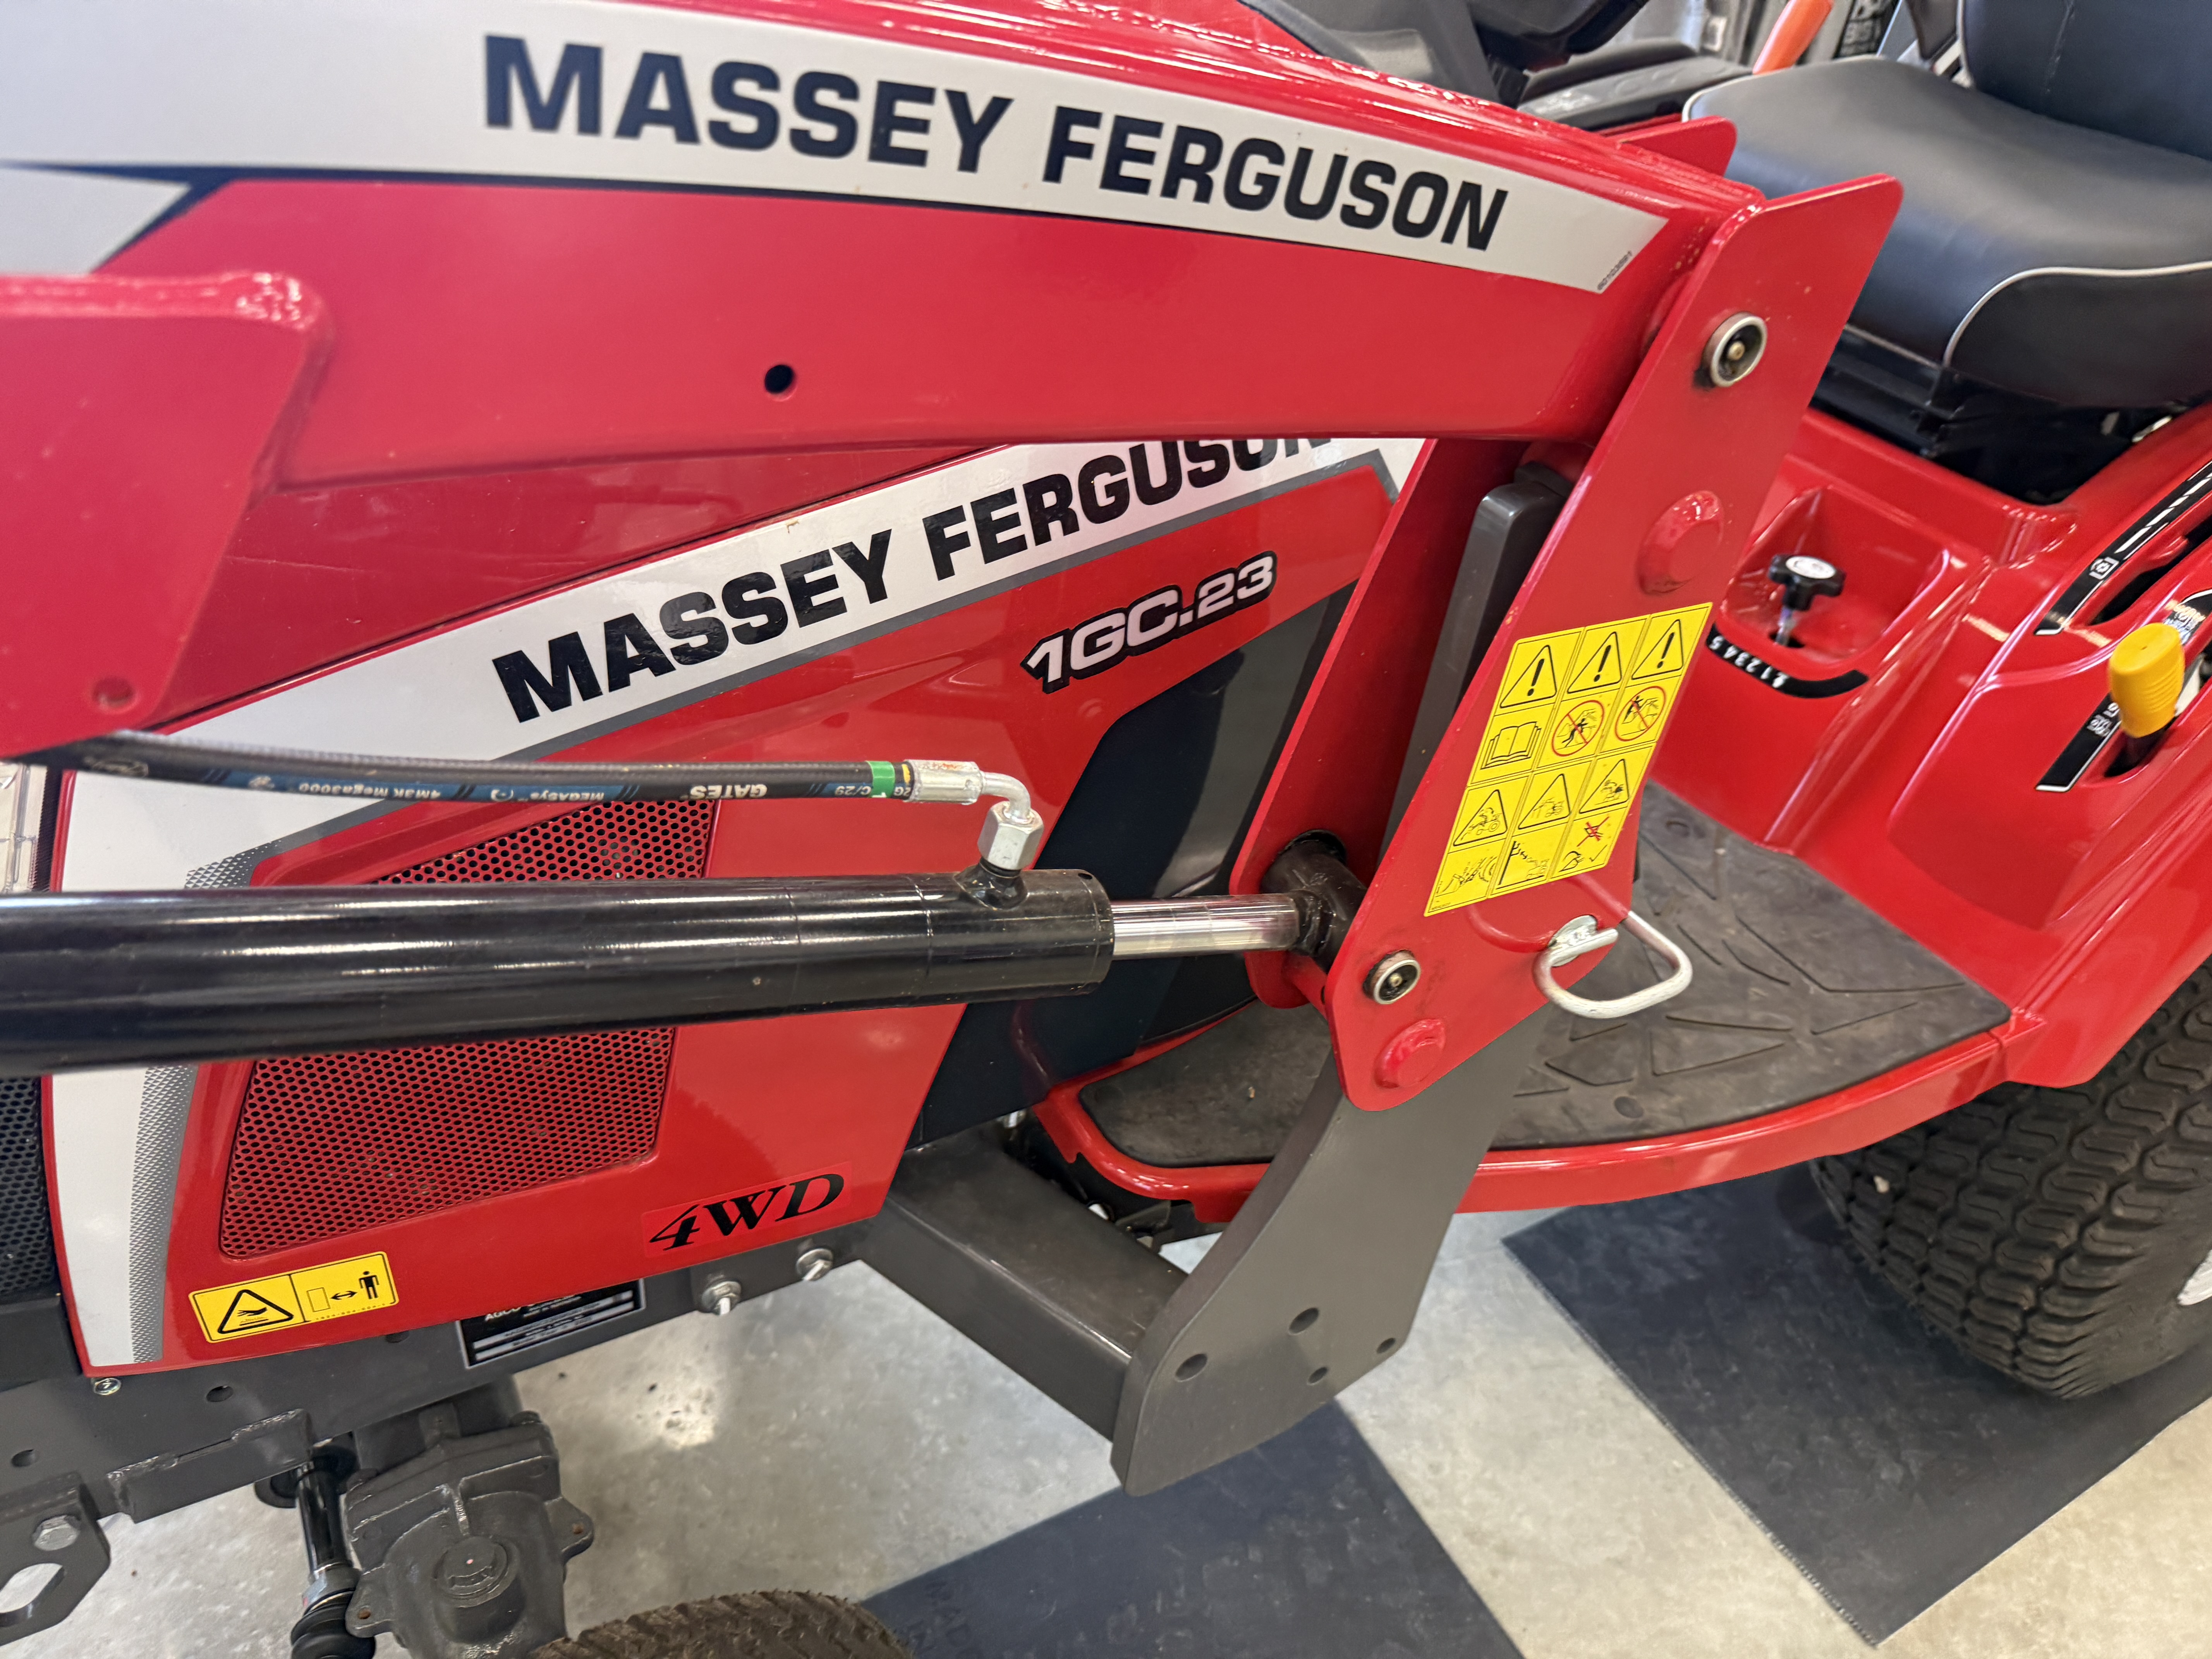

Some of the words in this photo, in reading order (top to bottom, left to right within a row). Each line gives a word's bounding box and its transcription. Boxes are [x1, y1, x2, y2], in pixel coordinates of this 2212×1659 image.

[485, 34, 1014, 173] MASSEY
[1042, 105, 1509, 252] FERGUSON
[491, 529, 893, 723] MASSEY
[1024, 553, 1276, 687] 1GC.23
[1709, 635, 1724, 650] 5
[1723, 645, 1739, 659] 4
[1734, 652, 1750, 666] 3
[1745, 657, 1762, 673] 2
[690, 783, 768, 799] GATES
[648, 1173, 845, 1252] 4WD
